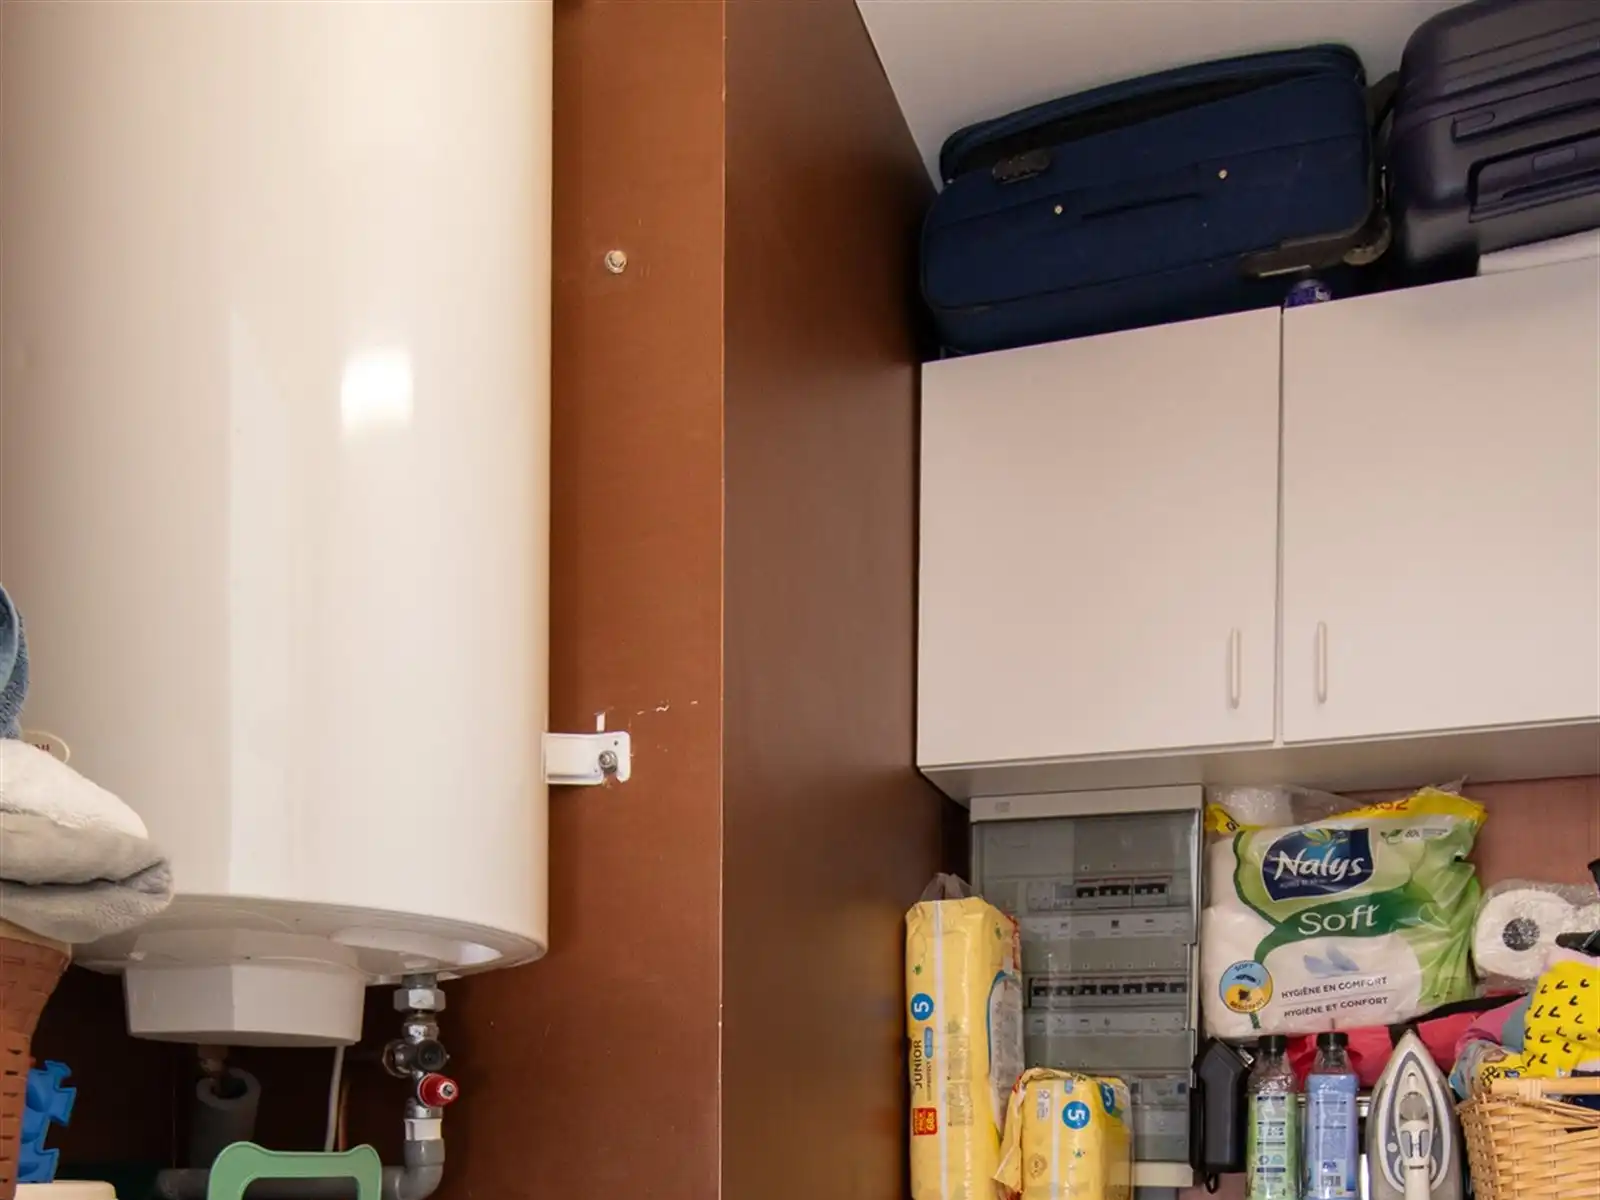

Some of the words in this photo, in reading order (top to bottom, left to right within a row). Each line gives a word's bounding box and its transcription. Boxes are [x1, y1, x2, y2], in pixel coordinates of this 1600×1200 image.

[1271, 846, 1365, 882] Nalys
[1298, 904, 1380, 935] Soft
[1323, 983, 1336, 993] EN
[914, 1001, 929, 1013] 5
[1325, 1003, 1338, 1013] ET
[1340, 997, 1388, 1010] CONFORT
[913, 1040, 922, 1088] JUNIOR
[1068, 1109, 1085, 1120] 5
